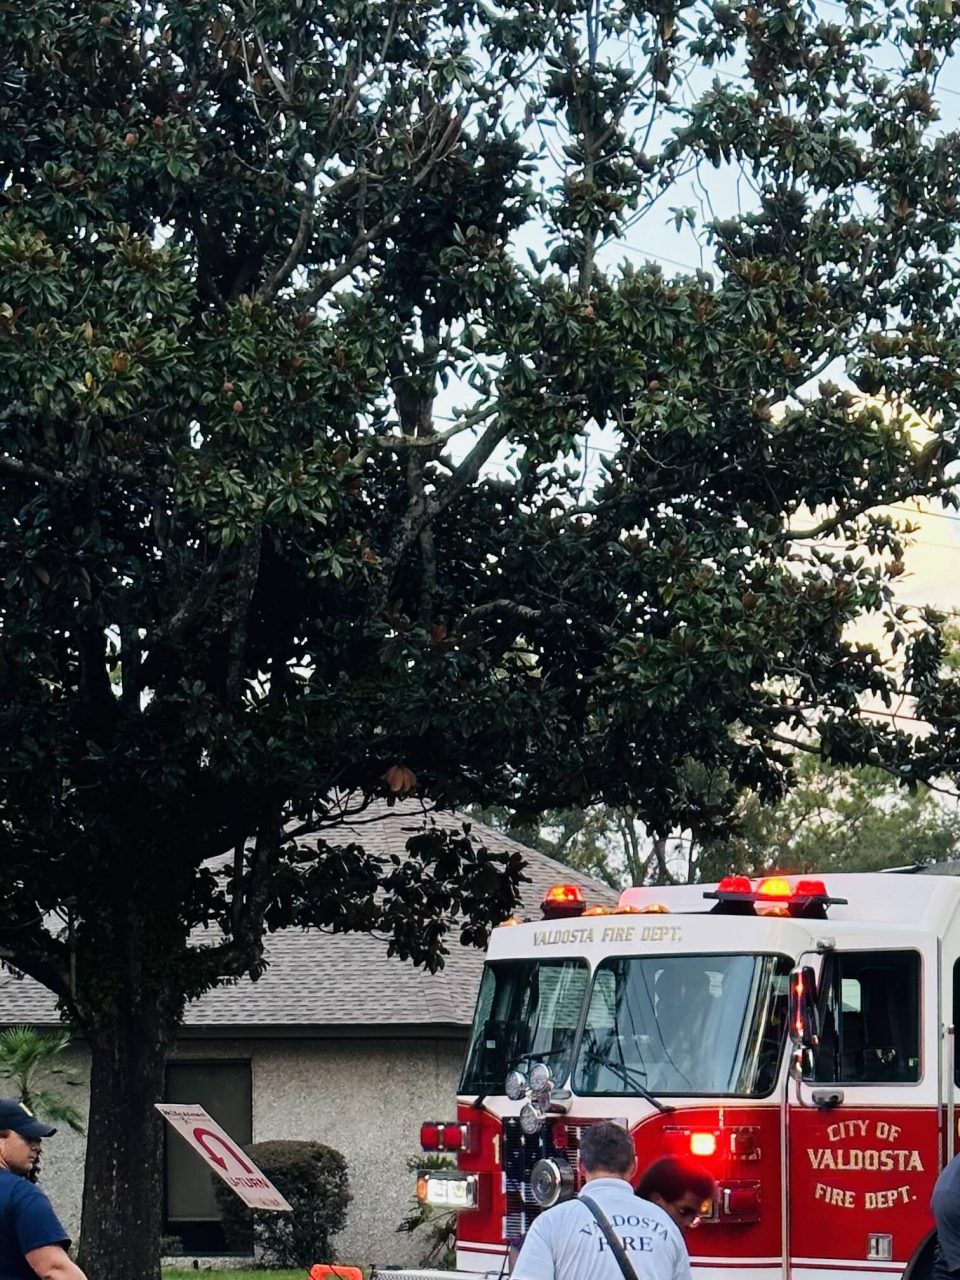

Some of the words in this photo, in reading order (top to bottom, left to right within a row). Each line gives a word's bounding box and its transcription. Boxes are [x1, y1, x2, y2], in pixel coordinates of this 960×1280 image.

[533, 928, 594, 946] VALDOSTA
[601, 926, 635, 942] FIRE
[641, 925, 683, 942] DEPT.
[827, 1119, 870, 1142] CITY
[876, 1121, 901, 1142] OF
[807, 1148, 925, 1172] VALDOSTA
[226, 1176, 270, 1190] U-TURN
[815, 1182, 857, 1209] FIRE
[864, 1184, 917, 1210] DEPT.
[598, 1235, 654, 1252] FRE
